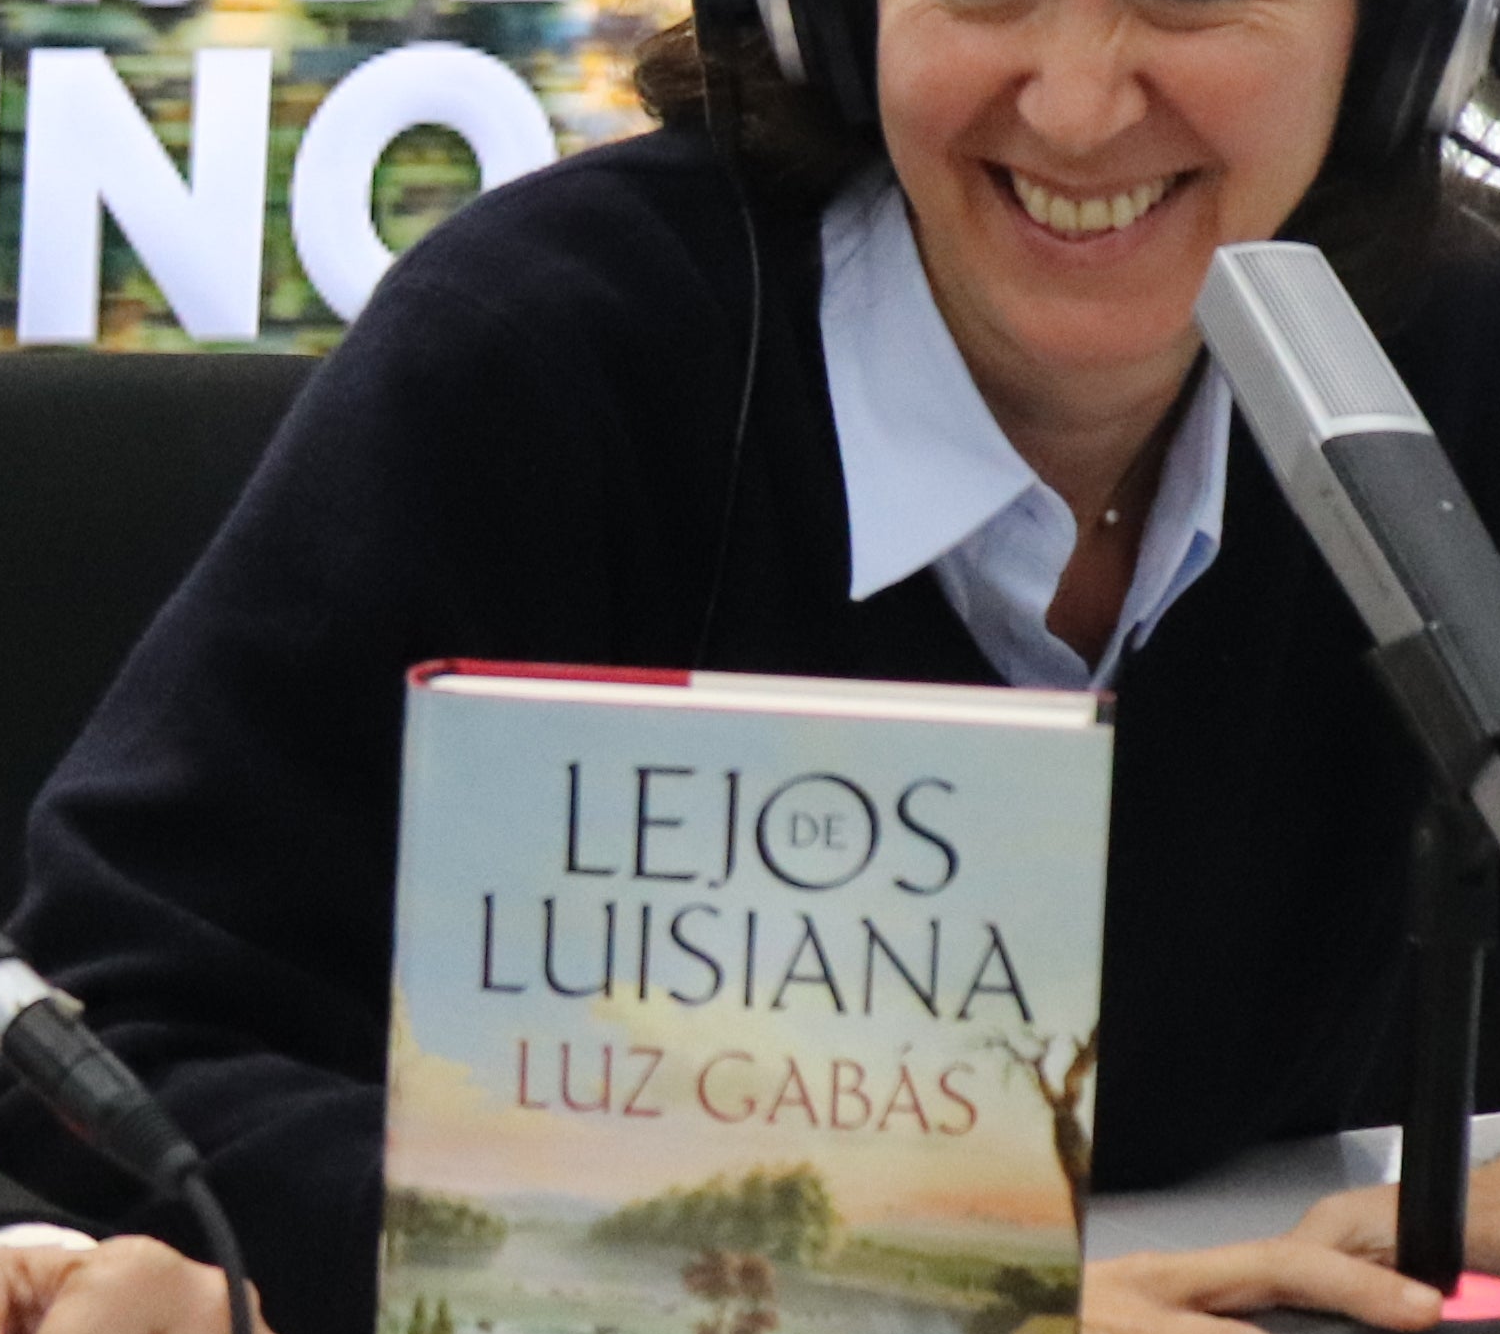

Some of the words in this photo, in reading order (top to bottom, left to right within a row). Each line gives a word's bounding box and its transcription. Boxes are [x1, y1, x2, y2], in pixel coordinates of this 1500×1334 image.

[564, 761, 960, 896] LEJOS
[788, 811, 847, 850] DE
[479, 892, 1034, 1024] LUISIANA
[516, 1038, 665, 1118] LUZ
[696, 1043, 979, 1136] GABÁS
